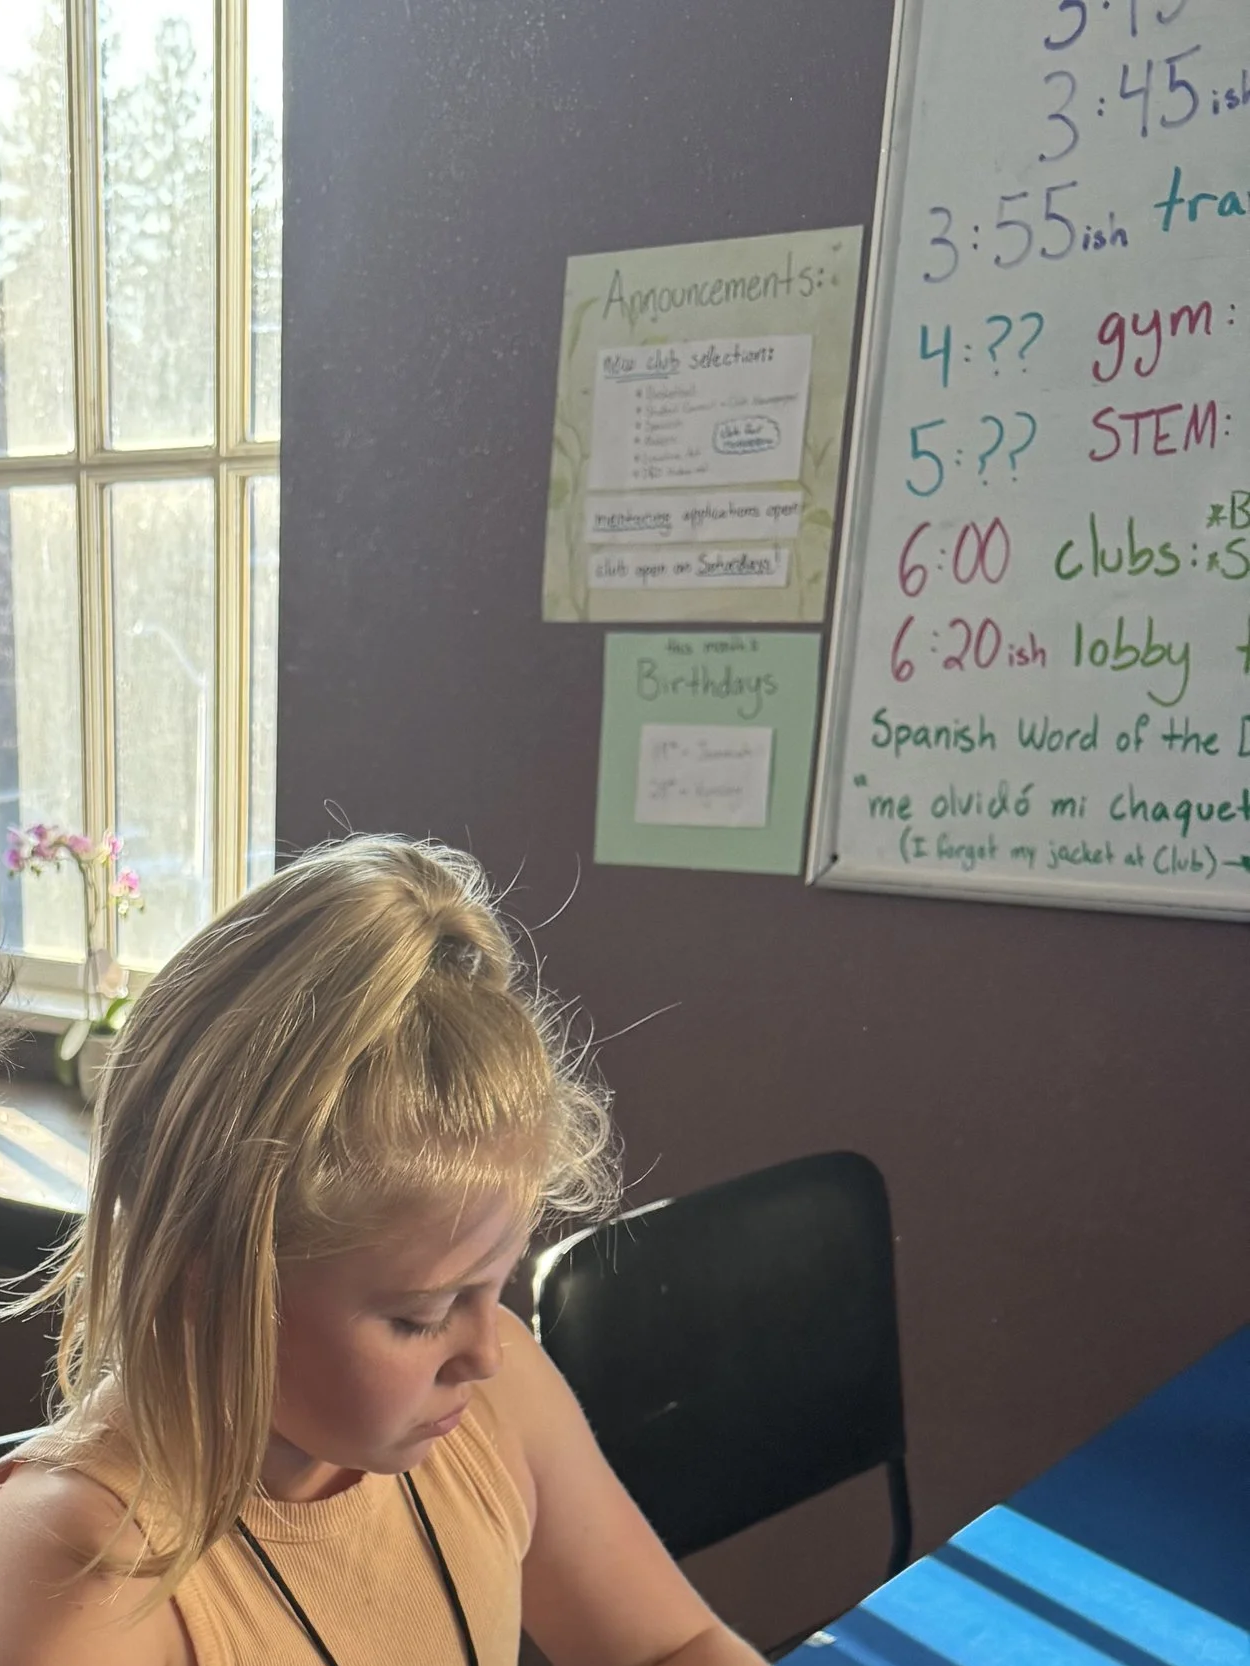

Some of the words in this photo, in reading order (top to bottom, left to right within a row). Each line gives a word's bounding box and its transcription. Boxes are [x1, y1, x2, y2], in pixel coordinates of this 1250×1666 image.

[1154, 166, 1250, 231] tra
[919, 311, 1045, 388] 4:??
[1092, 300, 1236, 383] gym:
[906, 410, 1038, 498] 5:??
[1089, 400, 1232, 462] STEM:
[899, 516, 1011, 598] 6:00
[1054, 511, 1198, 581] clubs:
[636, 656, 780, 721] Birthdays
[1074, 615, 1191, 707] lobby
[871, 707, 997, 759] Spanish
[1018, 712, 1099, 752] Word
[1116, 713, 1150, 753] of
[1161, 716, 1220, 756] the
[930, 779, 1035, 820] olvidó
[1051, 795, 1086, 815] mi
[1110, 782, 1250, 838] chaquet
[1010, 845, 1037, 869] my
[1047, 836, 1113, 870] jacket
[1124, 843, 1145, 868] at
